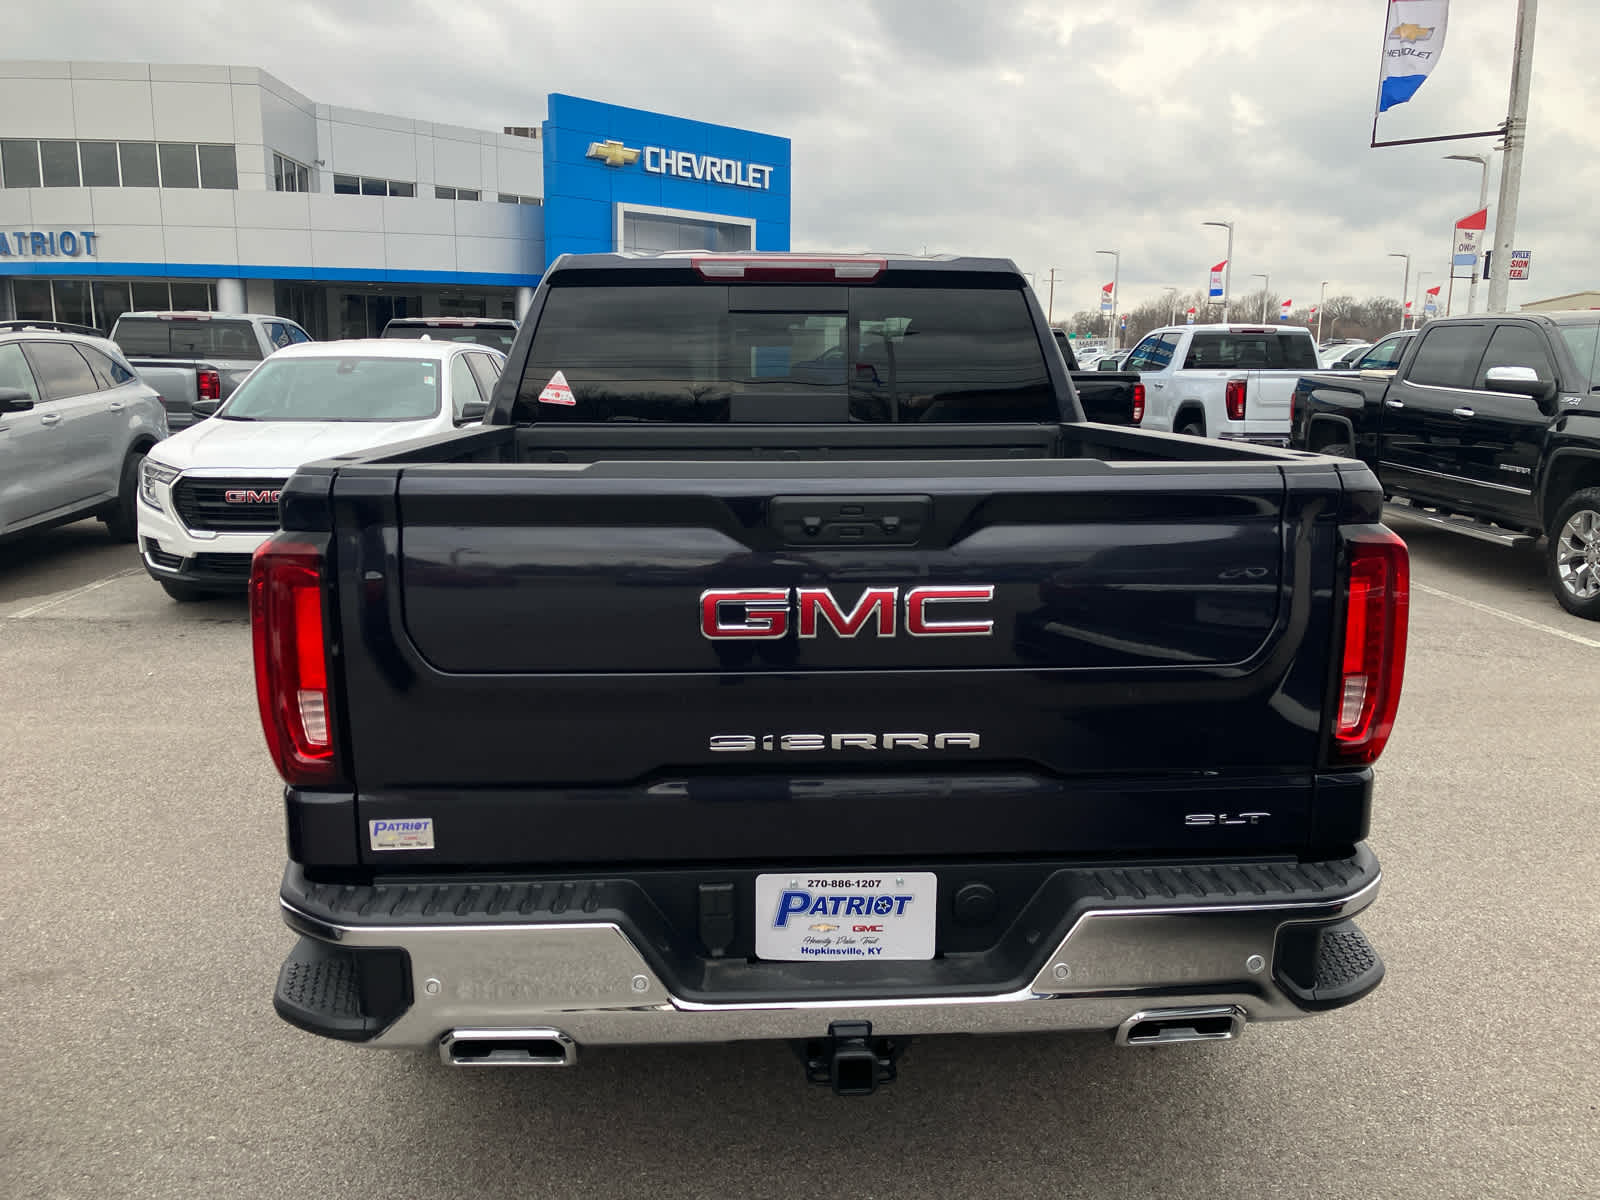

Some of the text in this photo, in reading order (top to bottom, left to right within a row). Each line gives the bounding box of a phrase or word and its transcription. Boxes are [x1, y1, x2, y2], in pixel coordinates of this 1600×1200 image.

[1385, 47, 1432, 59] HEVOLET
[643, 146, 774, 189] CHEVROLET
[700, 585, 995, 640] GMC
[709, 733, 981, 751] SIERRA
[1184, 812, 1272, 825] SLT
[373, 821, 430, 838] PATRIOT
[806, 879, 883, 888] 270-886-1207
[773, 889, 913, 928] PATRIOT
[852, 924, 884, 932] GMC
[801, 946, 883, 956] Hopkinsville, KY
